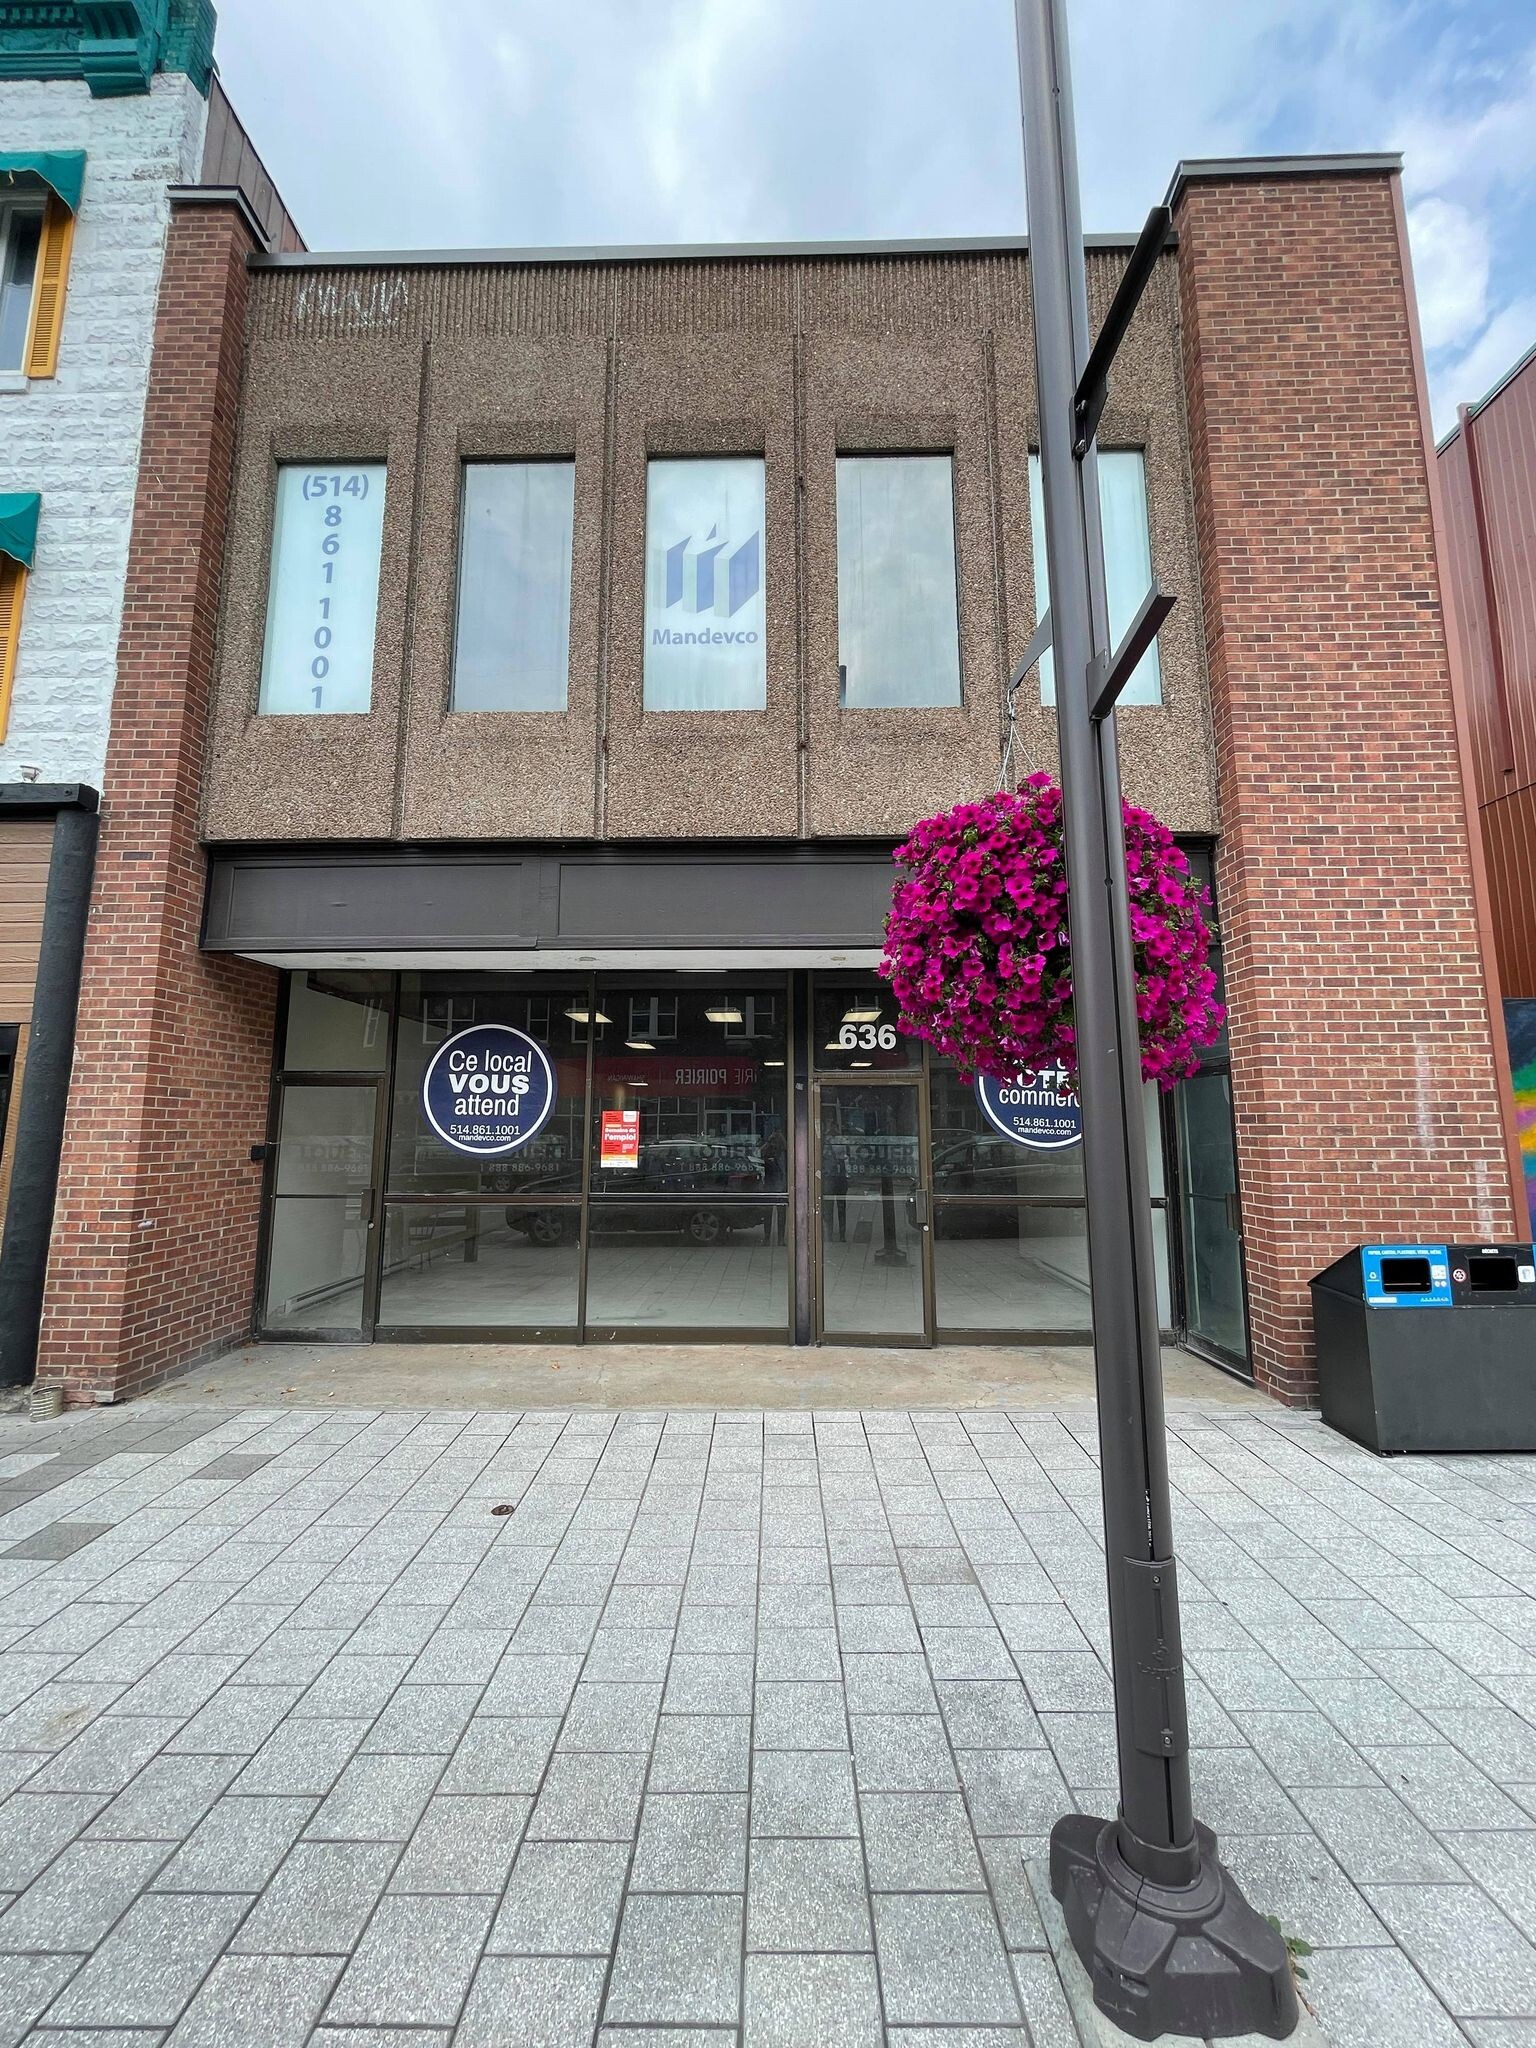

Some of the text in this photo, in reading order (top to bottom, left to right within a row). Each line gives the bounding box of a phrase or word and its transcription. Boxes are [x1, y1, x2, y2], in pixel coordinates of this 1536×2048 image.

[302, 474, 369, 501] (514)
[652, 627, 759, 645] Mandevco
[839, 1024, 897, 1050] 636
[449, 1049, 532, 1073] Ce local
[454, 1094, 520, 1116] attend
[450, 1124, 521, 1135] 514.861.1001
[1013, 1116, 1077, 1130] 514.861.1001
[1017, 1126, 1072, 1136] mandevco.com
[458, 1134, 512, 1142] mandevco.com
